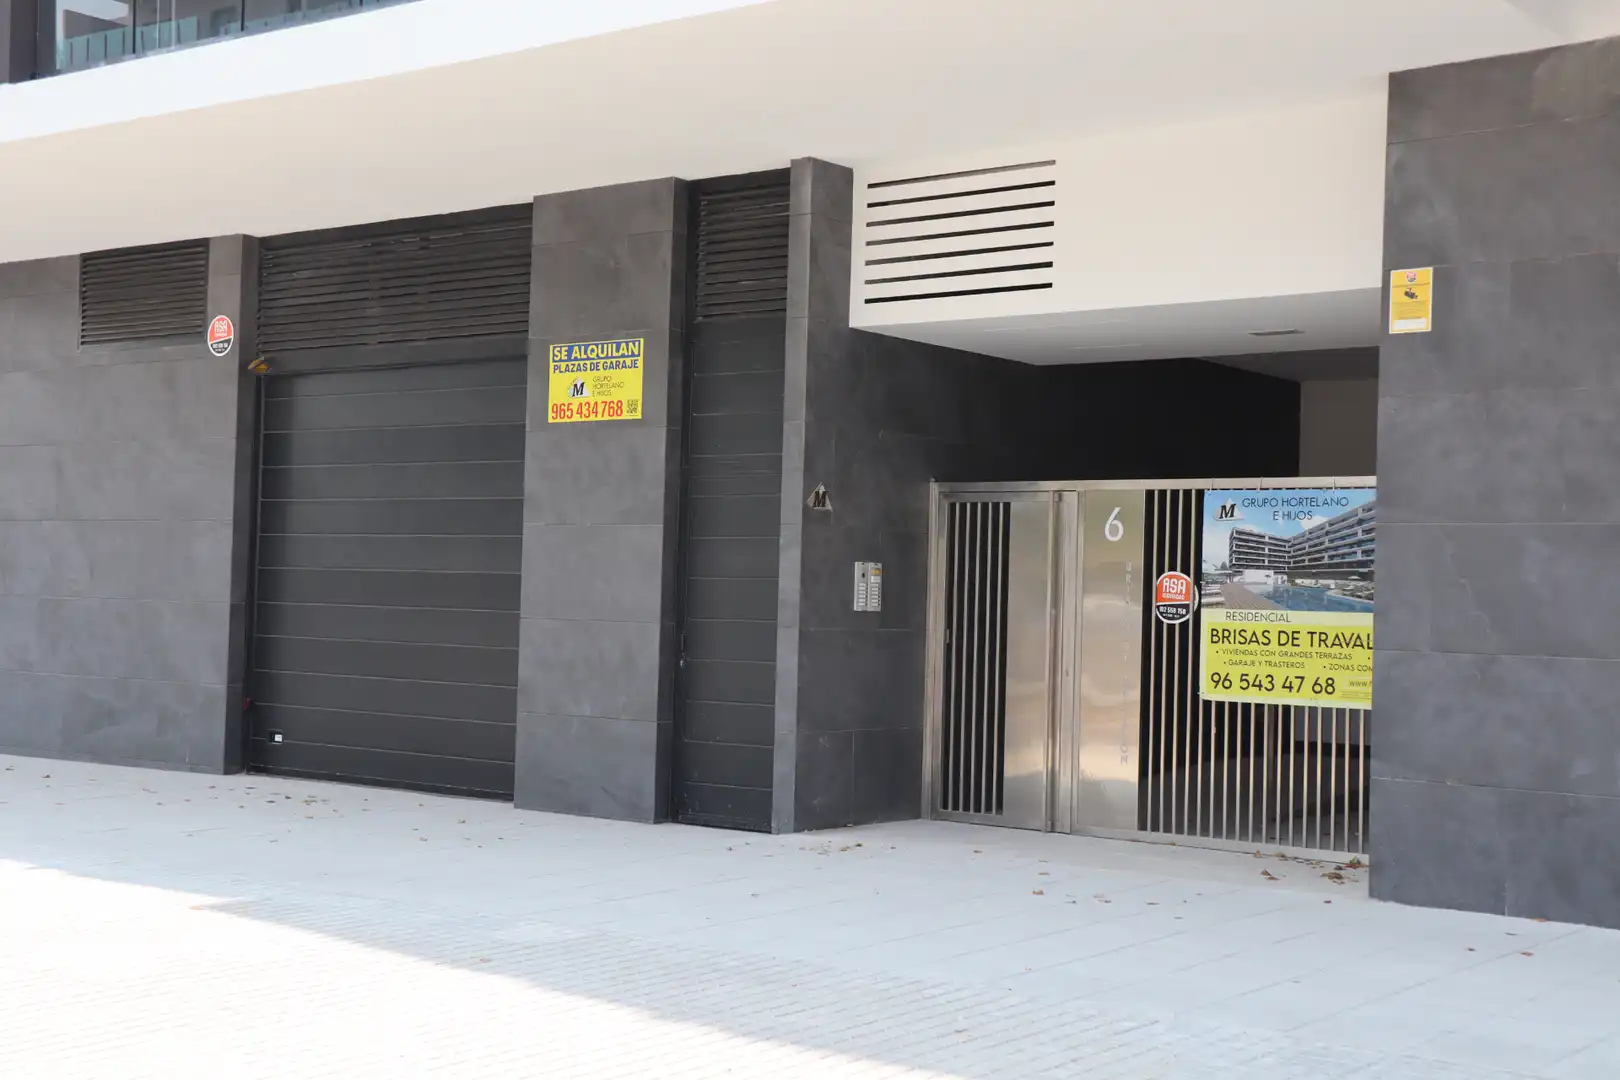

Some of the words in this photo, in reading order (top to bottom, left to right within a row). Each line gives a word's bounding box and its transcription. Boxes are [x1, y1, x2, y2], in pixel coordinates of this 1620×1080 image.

[553, 347, 569, 361] SE
[571, 341, 639, 360] ALQUILAN
[553, 362, 588, 374] PLAZAS
[590, 362, 601, 372] DE
[602, 359, 639, 371] GARAJE
[592, 375, 612, 383] GRUPO
[592, 382, 625, 390] HORTELANO
[572, 382, 585, 397] M
[597, 389, 612, 397] HIJOS
[552, 402, 574, 420] 965
[576, 401, 599, 419] 434
[601, 400, 623, 418] 768
[812, 490, 828, 508] M
[1242, 497, 1279, 508] GRUPO
[1281, 496, 1349, 508] HORTELANO
[1219, 503, 1237, 519] M
[1273, 511, 1279, 521] E
[1282, 510, 1313, 521] HIJOS
[1104, 506, 1124, 542] 6
[1162, 577, 1186, 594] ASA
[1225, 611, 1292, 623] RESIDENCIAL
[1210, 628, 1271, 646] BRISAS
[1277, 630, 1301, 648] DE
[1307, 631, 1374, 650] TRAVAL
[1222, 649, 1258, 657] VIVIENDAS
[1260, 649, 1276, 657] CON
[1278, 650, 1313, 659] GRANDES
[1315, 651, 1352, 661] TERRAZAS
[1228, 659, 1256, 667] GARAJE
[1264, 660, 1305, 669] TRASTEROS
[1328, 663, 1355, 672] ZONAS
[1210, 672, 1233, 690] 96
[1239, 674, 1275, 692] 543
[1281, 676, 1305, 693] 47
[1311, 677, 1336, 695] 68
